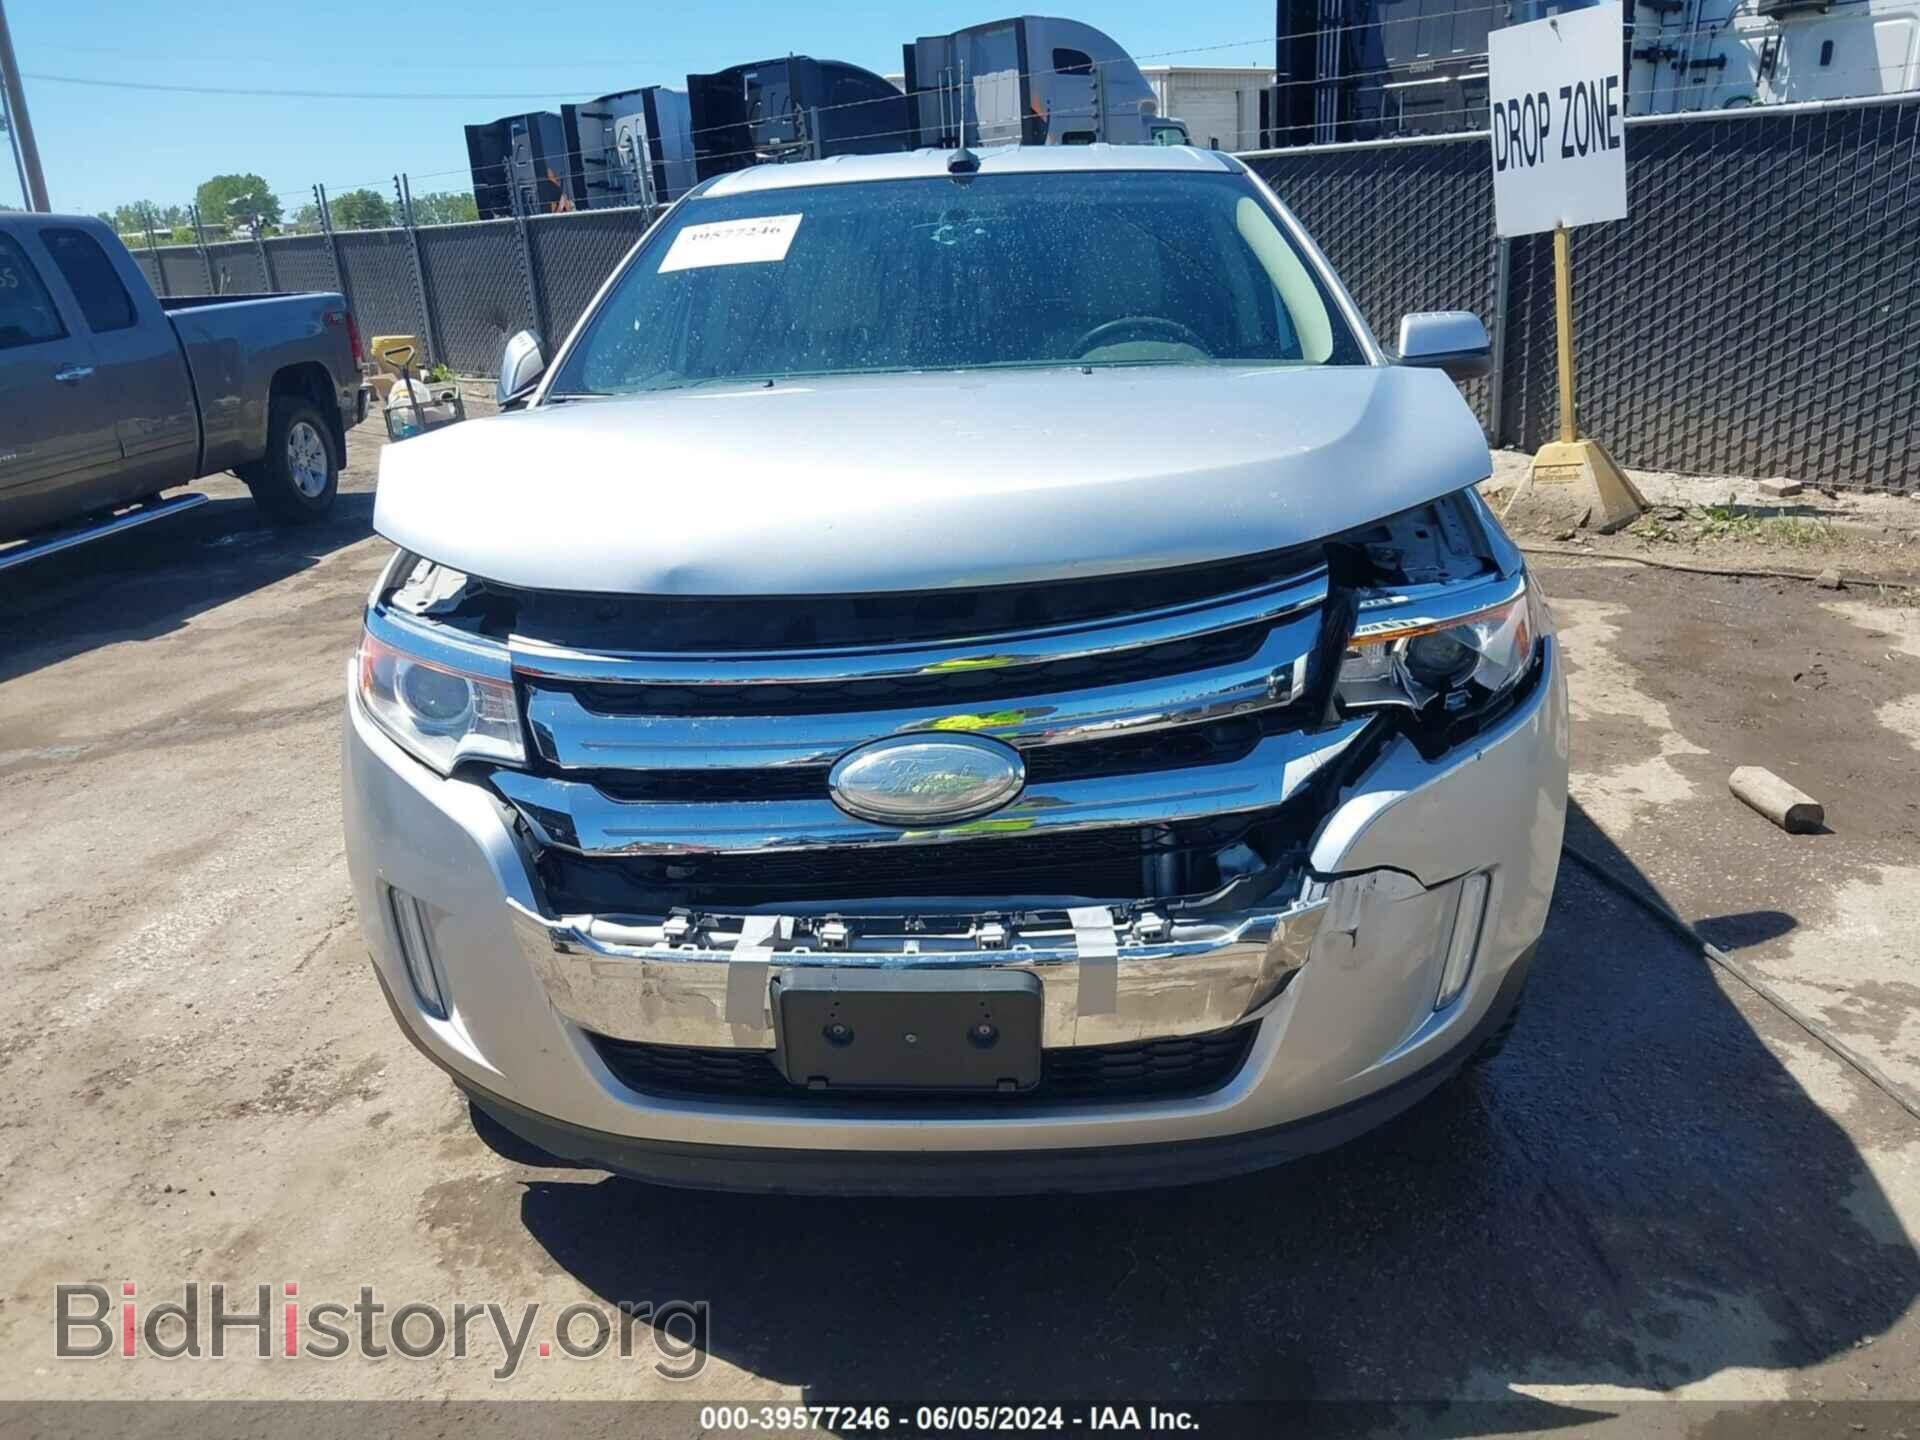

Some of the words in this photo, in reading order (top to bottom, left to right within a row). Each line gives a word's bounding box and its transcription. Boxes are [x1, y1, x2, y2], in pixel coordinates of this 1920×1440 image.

[1493, 91, 1550, 172] DROP
[1559, 75, 1621, 159] ZONE
[872, 756, 973, 793] Ford
